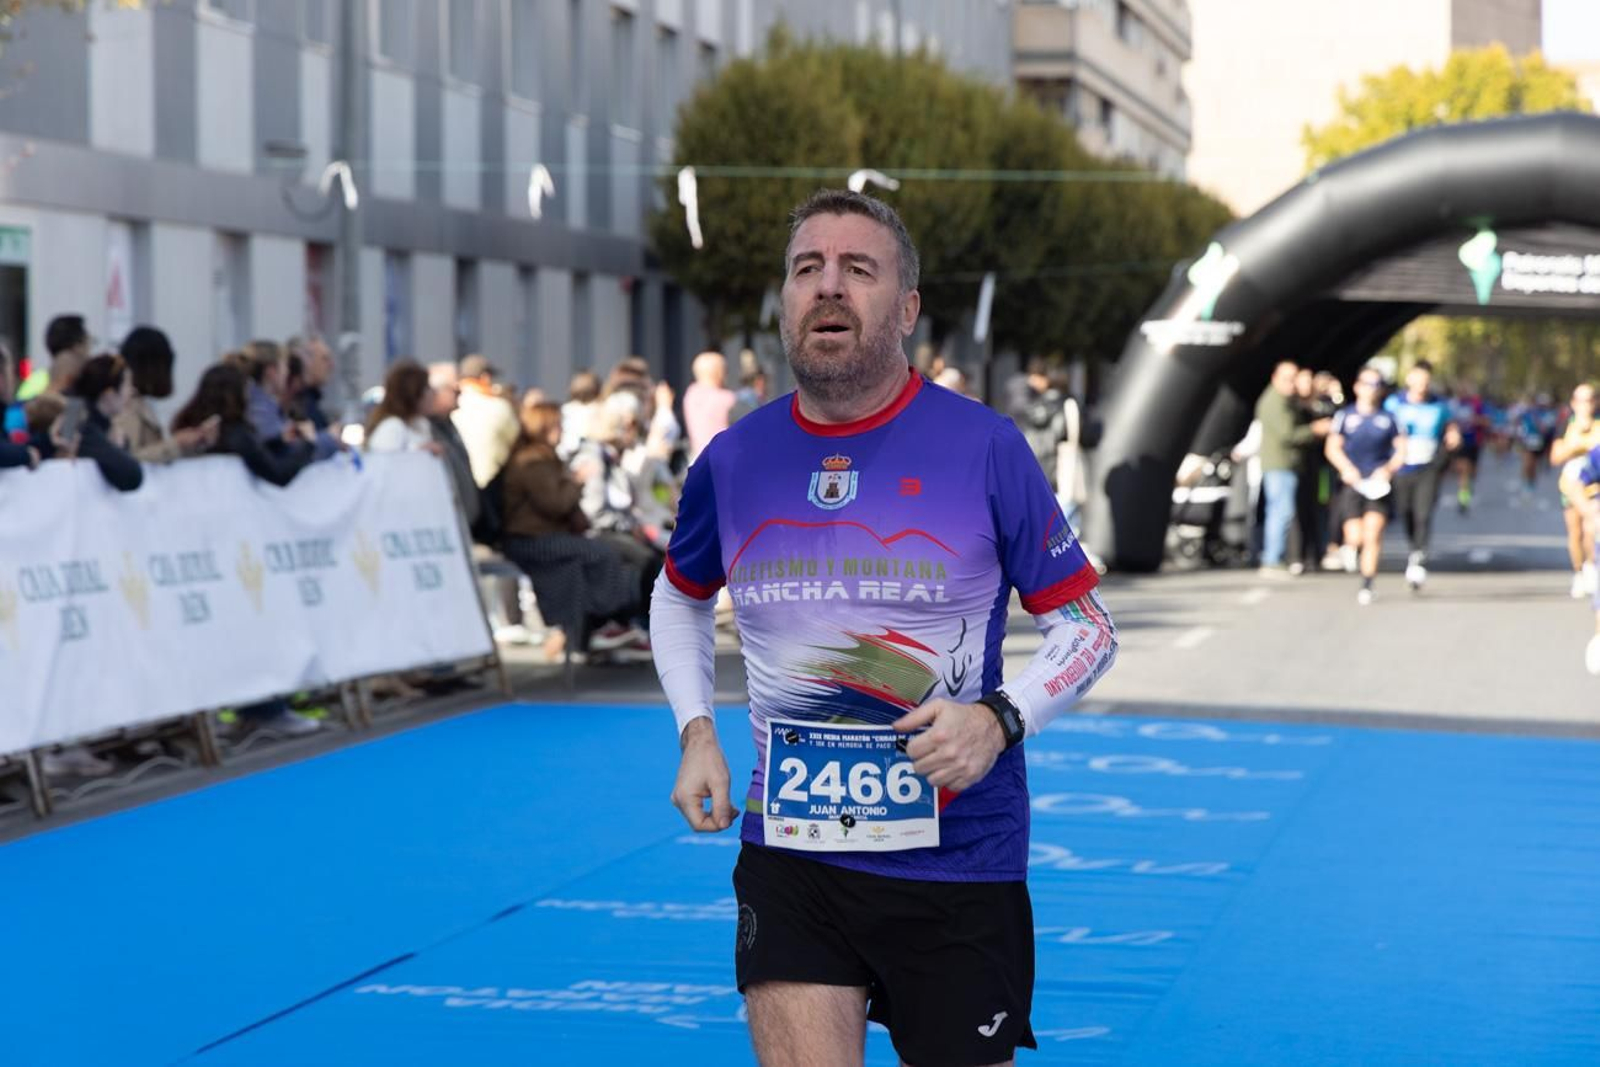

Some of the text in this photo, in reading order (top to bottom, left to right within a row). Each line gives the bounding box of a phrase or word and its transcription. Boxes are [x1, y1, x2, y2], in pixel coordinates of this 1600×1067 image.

[826, 558, 835, 577] Y
[732, 581, 952, 606] MANCHA REAL
[823, 733, 841, 741] MEDIA
[778, 757, 922, 805] 2466
[809, 805, 888, 816] JUAN ANTONIO
